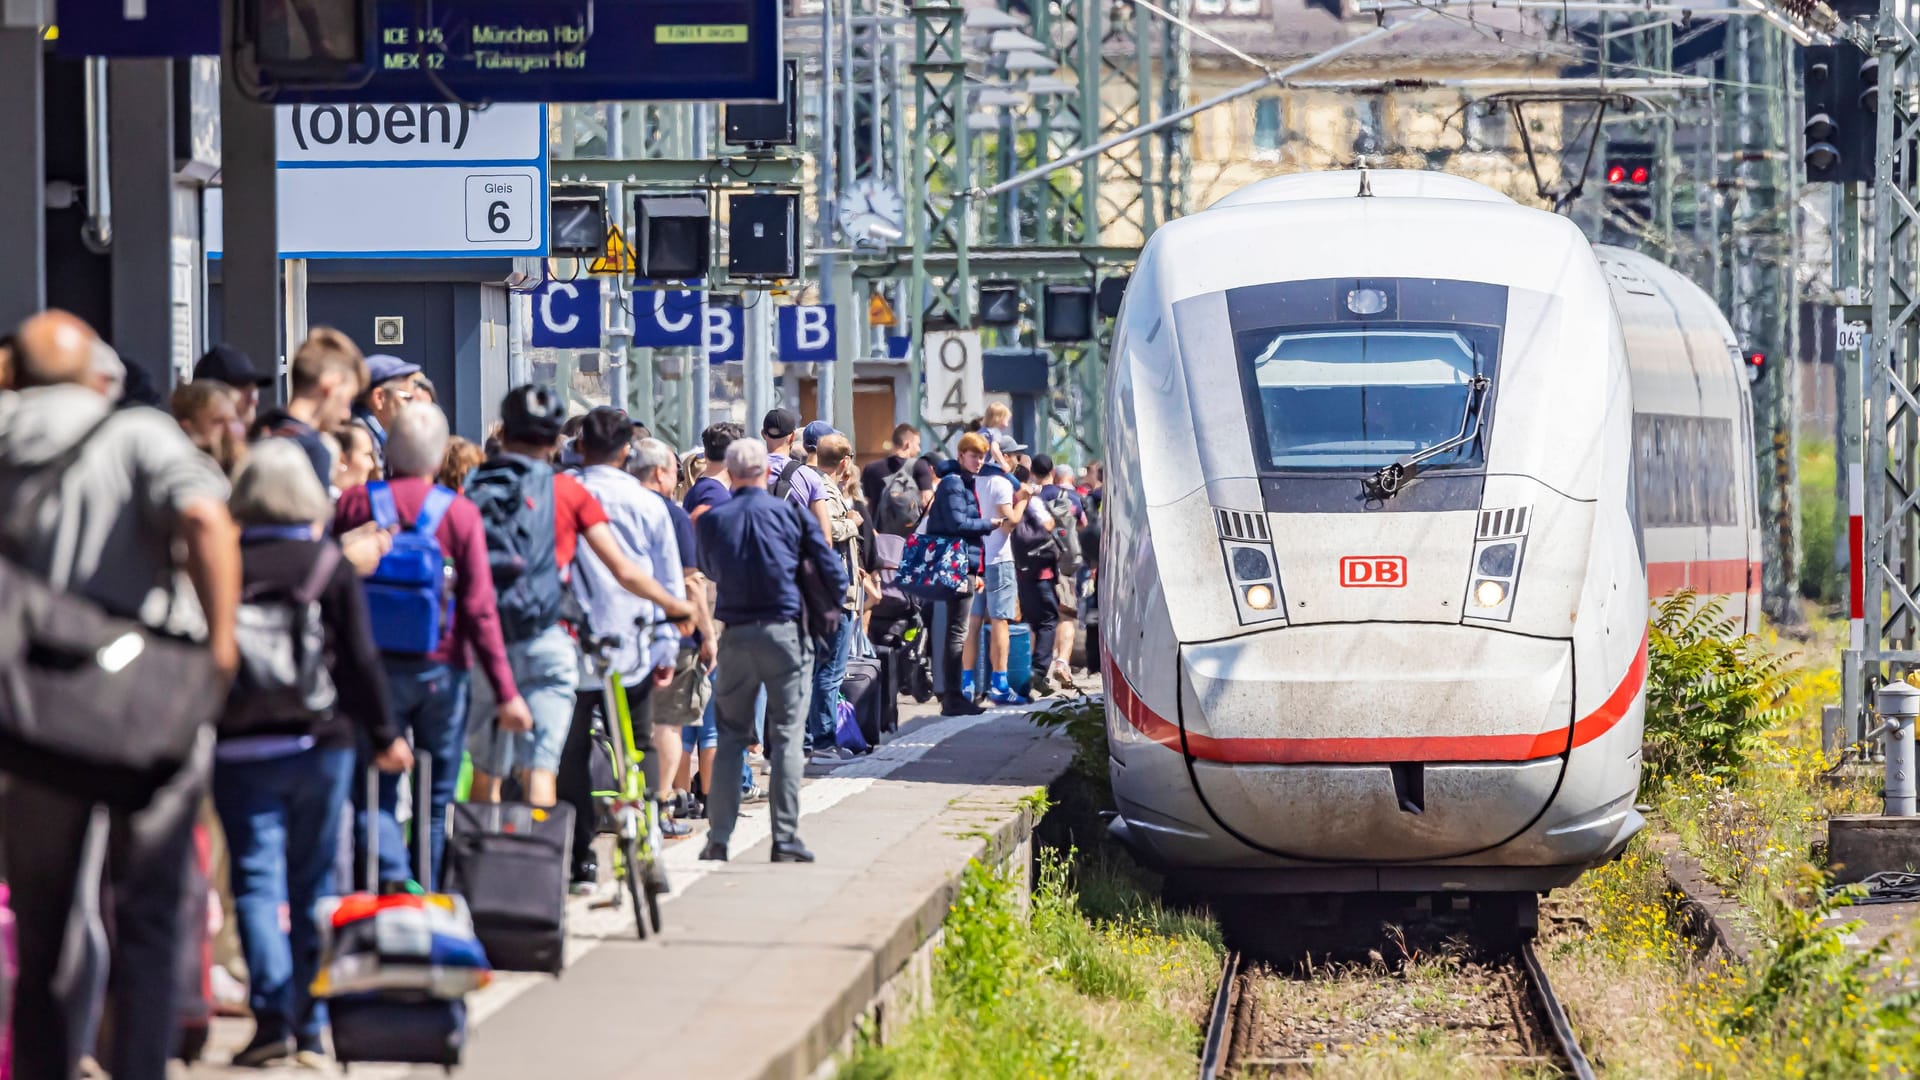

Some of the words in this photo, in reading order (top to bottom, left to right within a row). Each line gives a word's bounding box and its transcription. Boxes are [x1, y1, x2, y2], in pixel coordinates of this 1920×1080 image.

[384, 27, 408, 44] ICE
[473, 25, 549, 43] München
[555, 26, 584, 43] Hbf
[384, 53, 419, 69] MEX
[427, 53, 445, 69] 12
[475, 50, 550, 73] Tübingen
[555, 50, 586, 69] Hbf
[292, 103, 469, 150] (oben)
[484, 183, 513, 194] Gleis
[487, 200, 511, 234] 6
[541, 282, 579, 334] C
[654, 279, 693, 332] C
[702, 308, 734, 353] B
[796, 306, 830, 350] B
[941, 378, 968, 415] 4
[1348, 560, 1400, 583] DB
